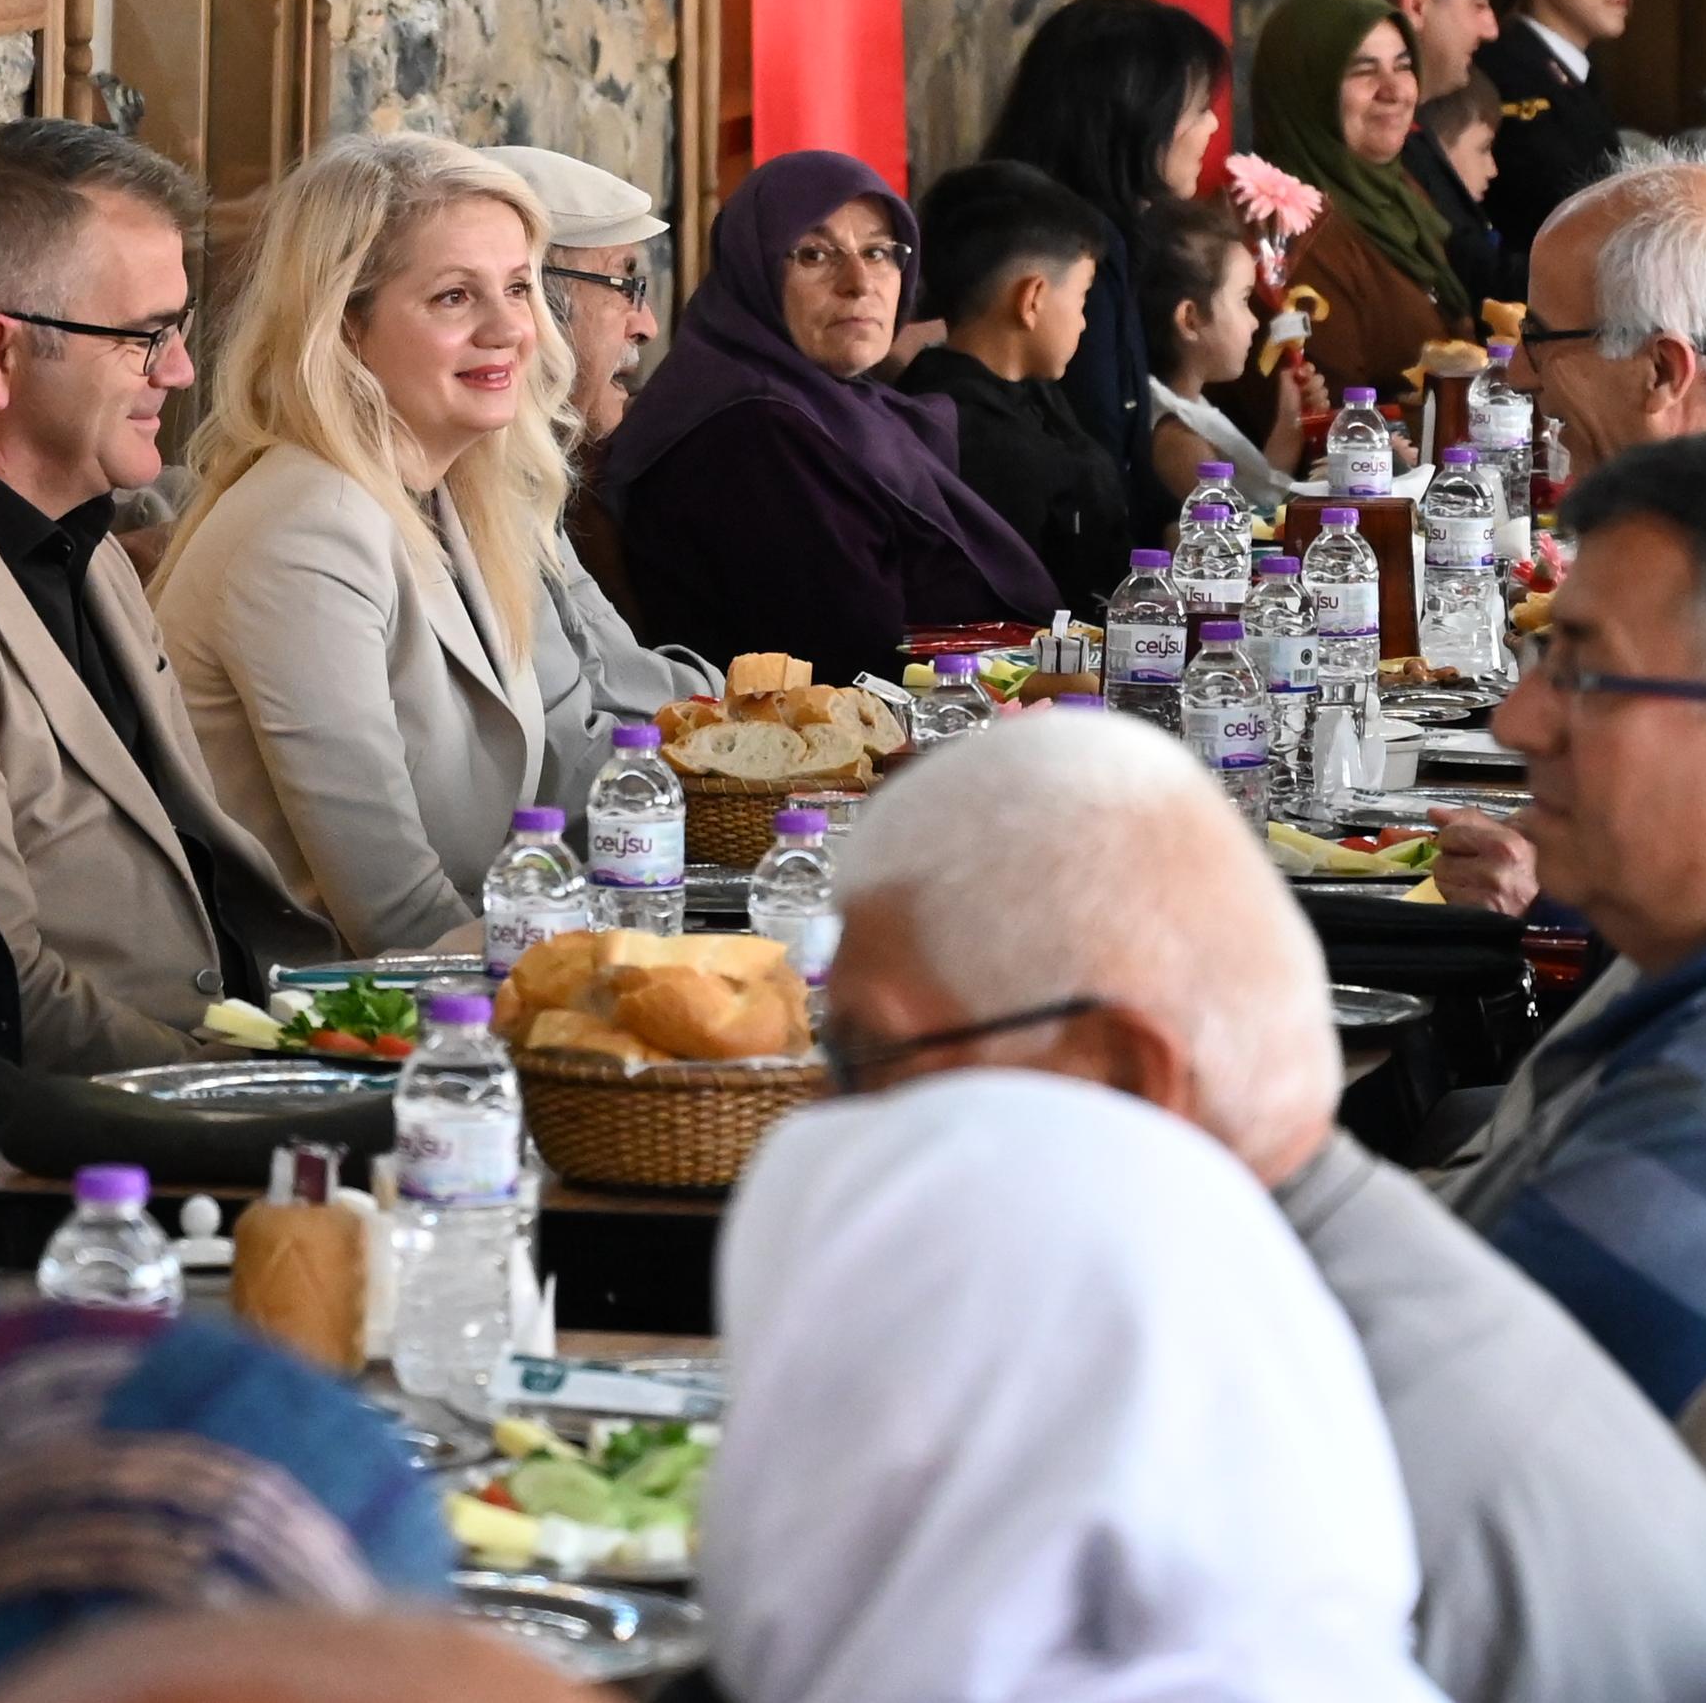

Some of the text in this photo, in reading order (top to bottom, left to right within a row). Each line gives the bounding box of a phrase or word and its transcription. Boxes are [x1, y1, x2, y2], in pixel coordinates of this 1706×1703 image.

[1135, 633, 1183, 658] ceysu
[594, 828, 653, 859] ceysu
[490, 916, 555, 950] ceys
